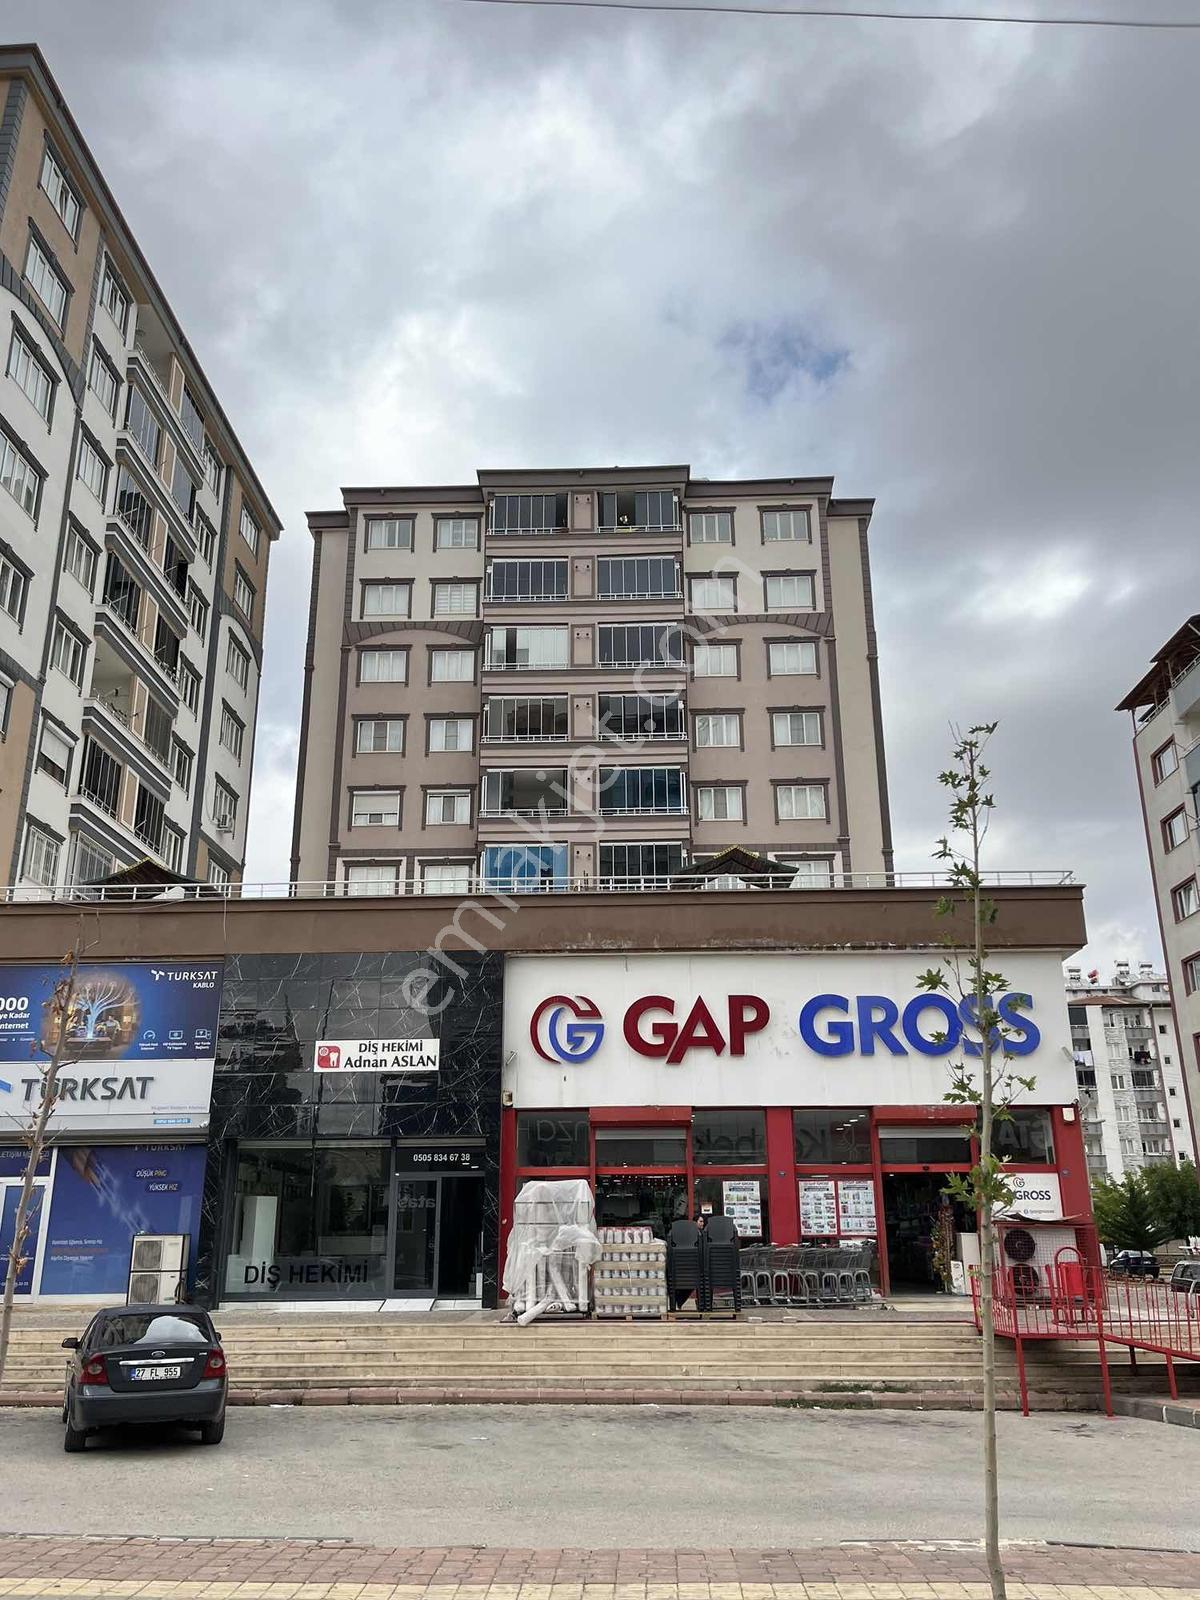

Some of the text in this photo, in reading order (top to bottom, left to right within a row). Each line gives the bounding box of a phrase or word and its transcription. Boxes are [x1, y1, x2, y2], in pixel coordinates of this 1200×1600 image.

[623, 992, 1041, 1065] GAP GROSS
[358, 1039, 423, 1055] DİŞ HEKİMİ
[343, 1055, 437, 1068] Adnan ASLAN
[413, 1153, 471, 1161] 0505 834 67 38
[1015, 1190, 1051, 1200] GROSS
[244, 1260, 368, 1289] DİŞ HEKİMİ
[136, 1367, 178, 1378] 27 FL 955
